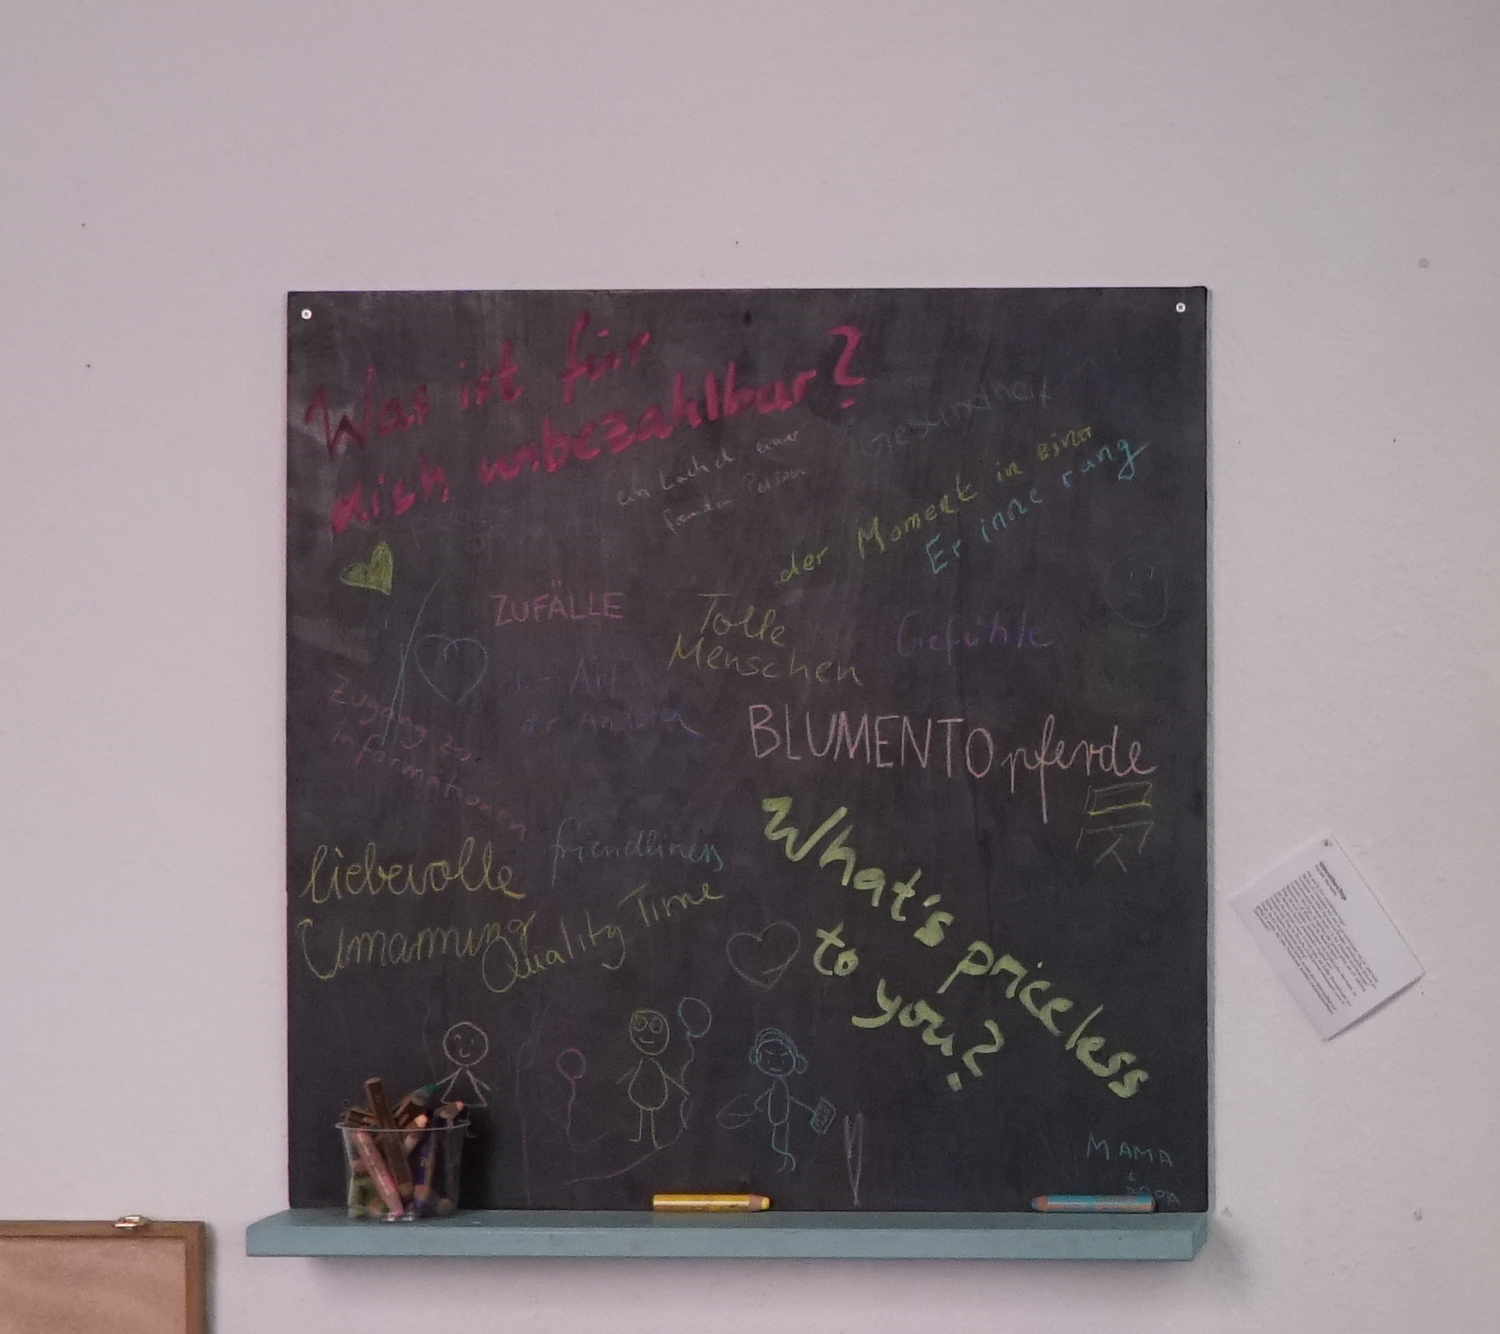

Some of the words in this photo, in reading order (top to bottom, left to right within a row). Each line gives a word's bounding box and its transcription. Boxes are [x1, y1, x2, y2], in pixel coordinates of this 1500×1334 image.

[303, 365, 429, 459] Was
[458, 341, 523, 410] ist
[559, 316, 650, 405] für
[331, 454, 451, 535] dich
[780, 546, 829, 583] der
[995, 456, 1023, 484] in
[489, 579, 625, 627] ZUFÄLLE
[698, 592, 786, 648] Tolle
[667, 633, 864, 687] Menschen
[481, 910, 627, 994] Quality
[616, 882, 725, 927] Time
[762, 795, 954, 948] What's
[937, 939, 1150, 1099] priceless
[812, 921, 859, 977] to
[851, 978, 1005, 1092] you?
[1086, 1131, 1174, 1168] MAMA
